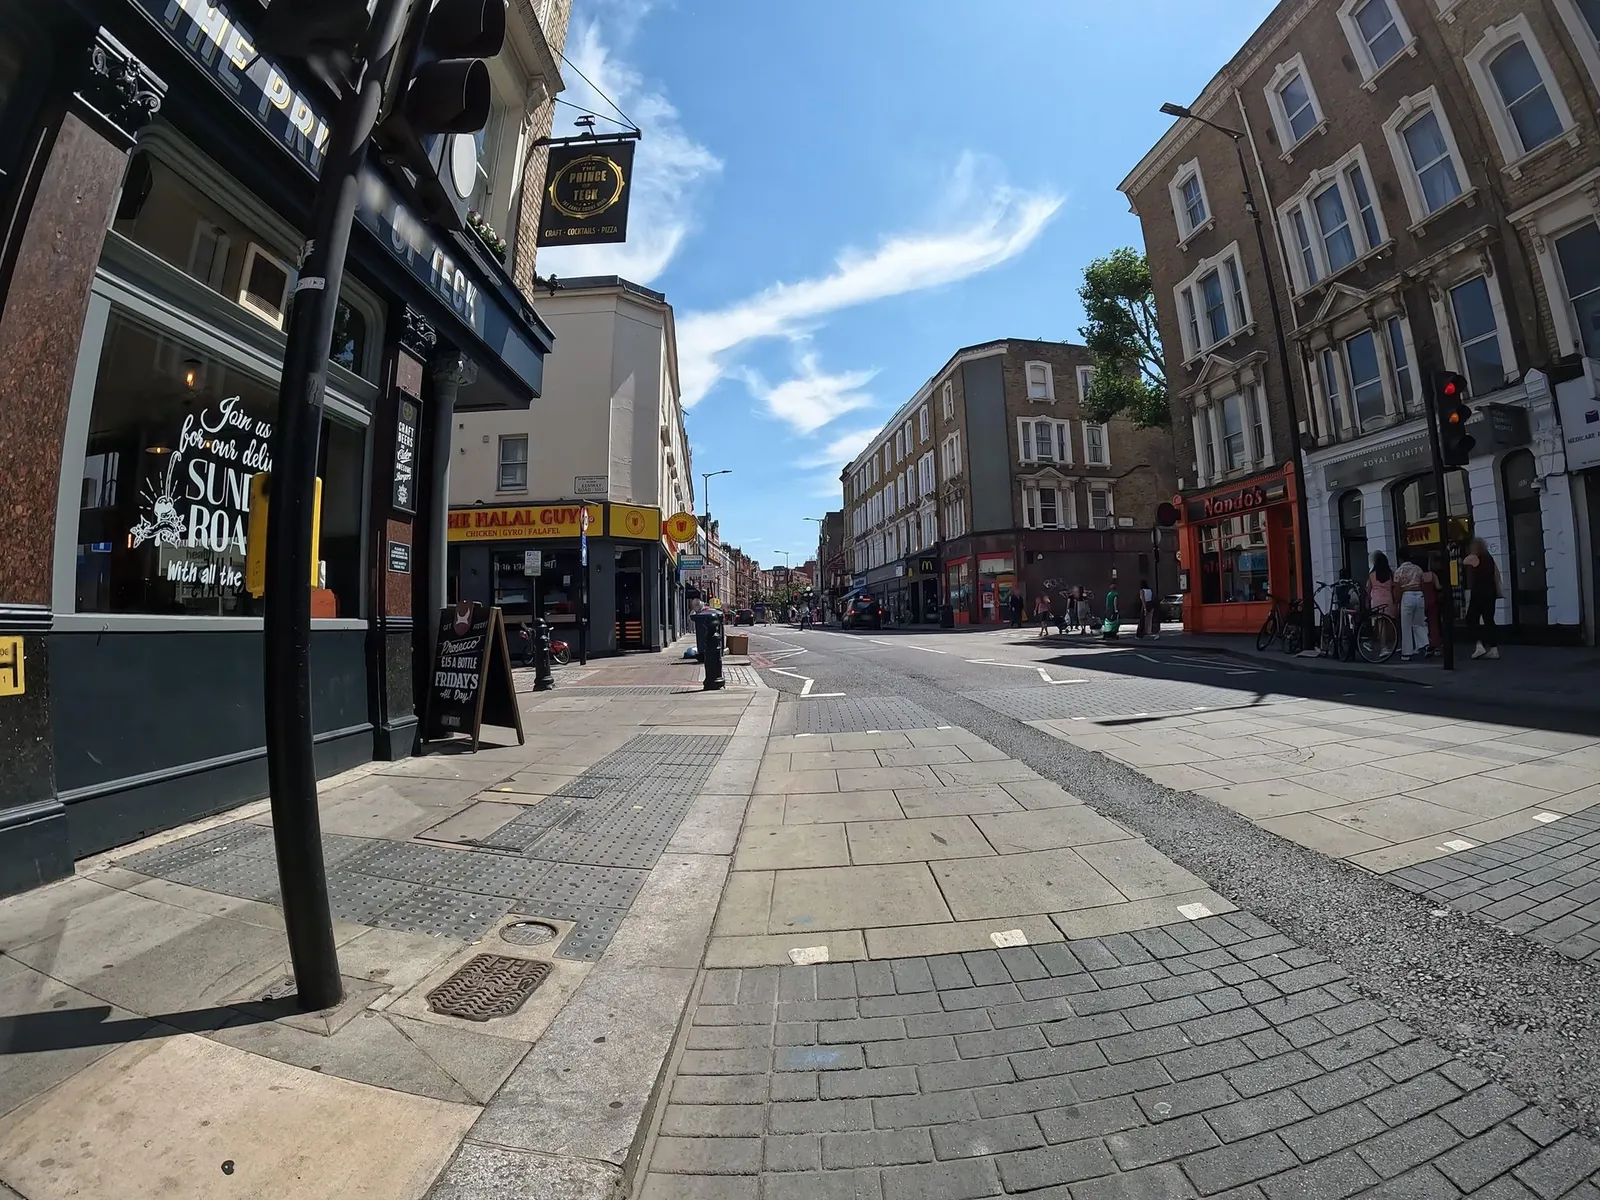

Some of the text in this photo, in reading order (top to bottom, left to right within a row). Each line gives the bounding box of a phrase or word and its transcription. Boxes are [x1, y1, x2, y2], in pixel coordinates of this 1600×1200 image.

[569, 170, 607, 183] PRINCE
[573, 189, 599, 201] TECK
[545, 226, 618, 237] CRAFT COCKTAILS PIZZA
[430, 246, 477, 330] TECK
[200, 395, 272, 438] Join us
[179, 414, 207, 454] for
[211, 438, 239, 460] our
[398, 421, 415, 438] CRAFT
[1567, 432, 1595, 444] MEDICARE
[397, 432, 414, 448] BEERS
[1363, 445, 1424, 468] ROYAL TRINITY
[1204, 485, 1263, 516] Nando's
[447, 507, 580, 529] HE HALAL GUY
[465, 527, 561, 539] CHICKEN GYRO FALAFEL
[166, 560, 243, 587] With all the
[441, 636, 480, 655] Prosecco
[452, 657, 457, 668] A
[457, 657, 477, 669] BOTTLE
[434, 671, 479, 690] FRIDAYS
[440, 688, 473, 704] All Day!
